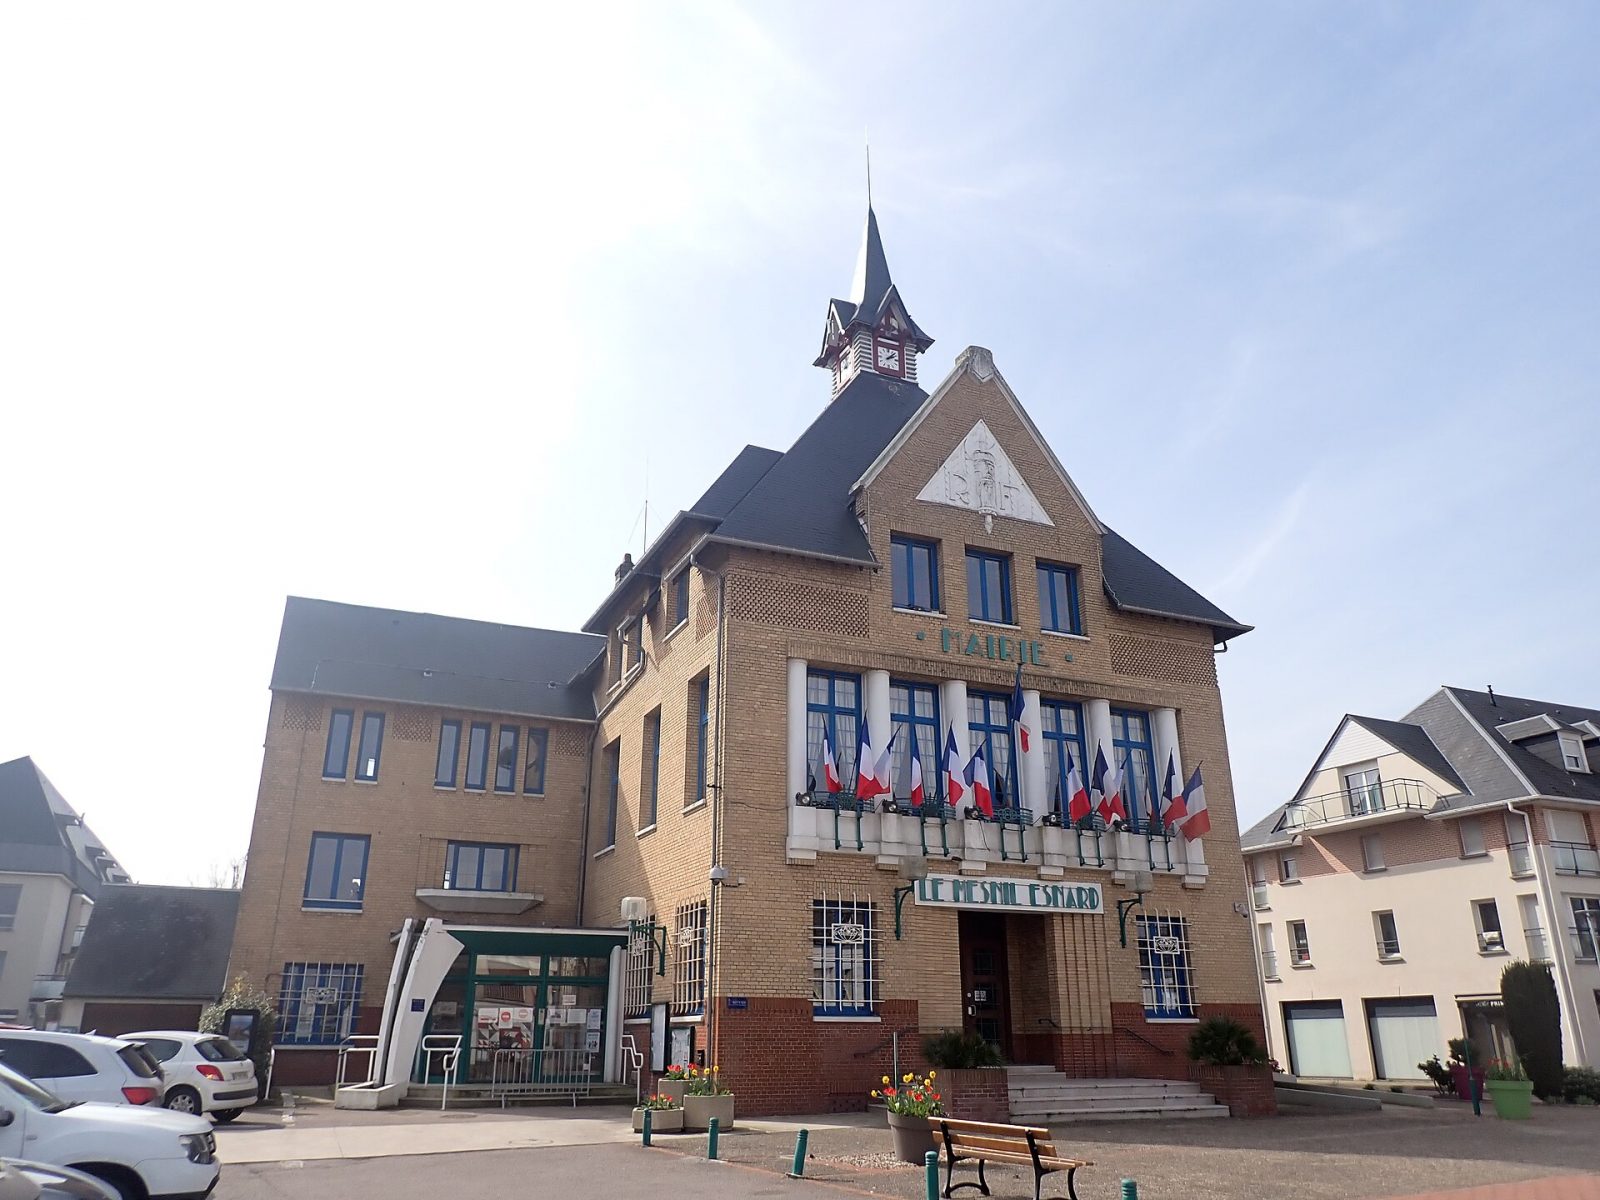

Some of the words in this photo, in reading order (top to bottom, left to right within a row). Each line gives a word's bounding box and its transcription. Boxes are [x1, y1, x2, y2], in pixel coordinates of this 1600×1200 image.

[941, 627, 1049, 667] MAIRIE
[919, 877, 944, 901] LE
[952, 878, 1021, 905] MESNIL
[1028, 883, 1099, 910] ESNARD
